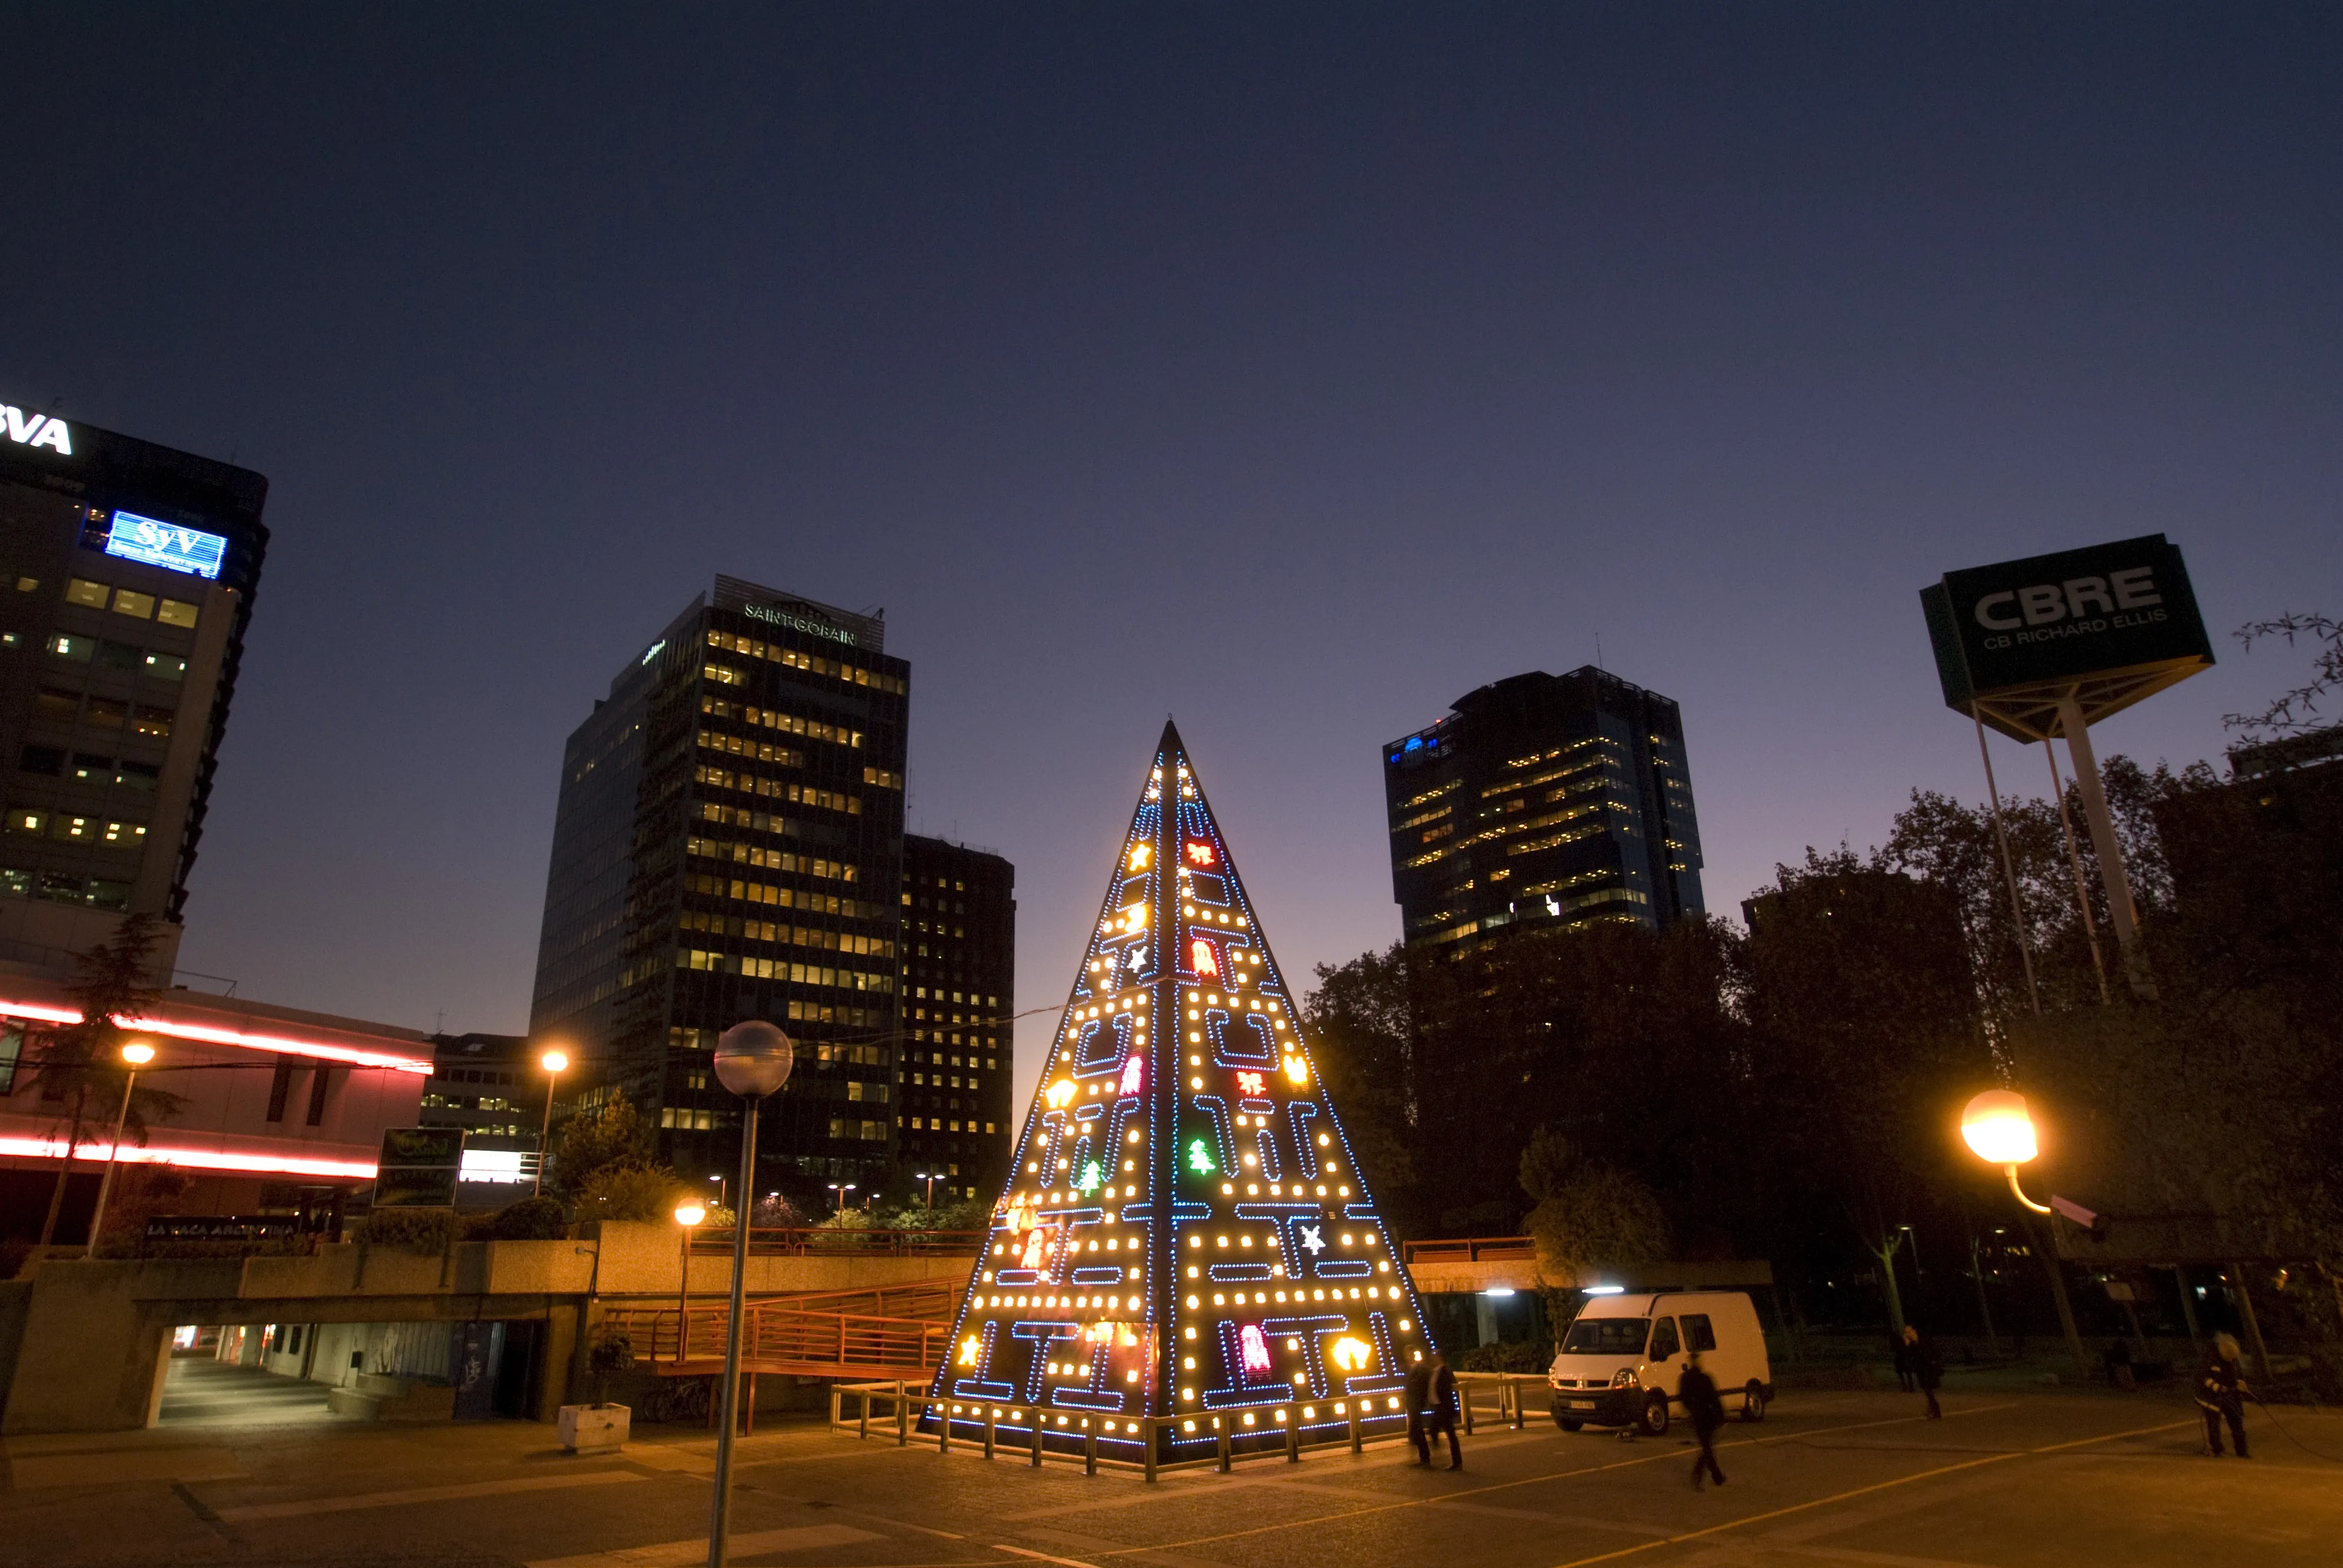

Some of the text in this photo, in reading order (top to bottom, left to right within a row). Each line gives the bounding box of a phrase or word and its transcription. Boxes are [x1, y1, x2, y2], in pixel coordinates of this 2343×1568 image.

[0, 403, 71, 455] VA
[134, 521, 202, 554] SyV
[1974, 566, 2163, 630] CBRE
[745, 604, 857, 646] SAINT-GOBAIN
[1984, 609, 2168, 650] CB RICHARD ELLIS
[147, 1224, 165, 1235] LA
[169, 1224, 208, 1235] VACA
